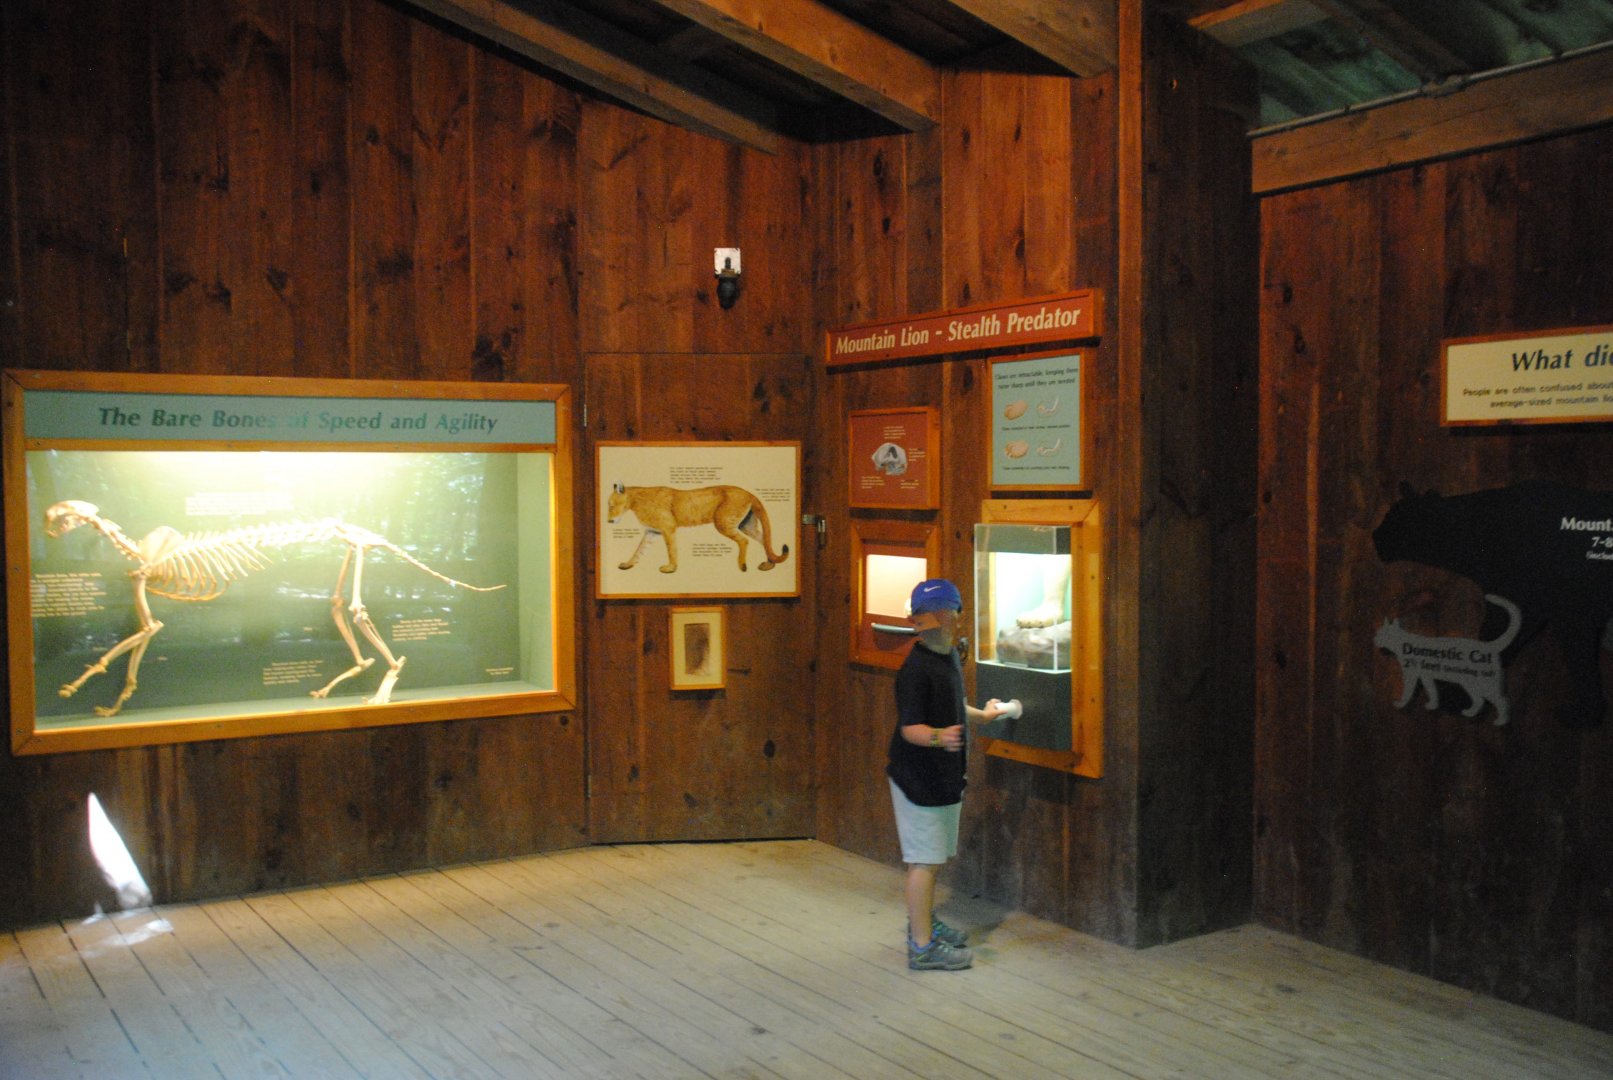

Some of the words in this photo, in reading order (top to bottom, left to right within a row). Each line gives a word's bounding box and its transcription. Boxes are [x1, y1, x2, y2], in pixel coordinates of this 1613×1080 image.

[836, 328, 896, 355] Mountain
[901, 325, 929, 347] Lion
[948, 313, 1001, 342] Stealth
[1006, 306, 1081, 334] Predator
[1512, 348, 1574, 372] What
[1463, 387, 1491, 397] People
[1495, 388, 1509, 396] are
[1512, 386, 1536, 395] often
[1539, 383, 1583, 393] confused
[1490, 397, 1553, 409] average-sized
[1556, 395, 1599, 405] mountain
[100, 407, 141, 428] The
[152, 408, 202, 429] Bare
[212, 409, 277, 429] Bones
[317, 411, 382, 434] Speed
[390, 412, 427, 431] and
[435, 413, 498, 435] Agility
[1560, 516, 1613, 532] Mount
[1402, 642, 1464, 661] Domestic
[1469, 649, 1493, 664] Cat
